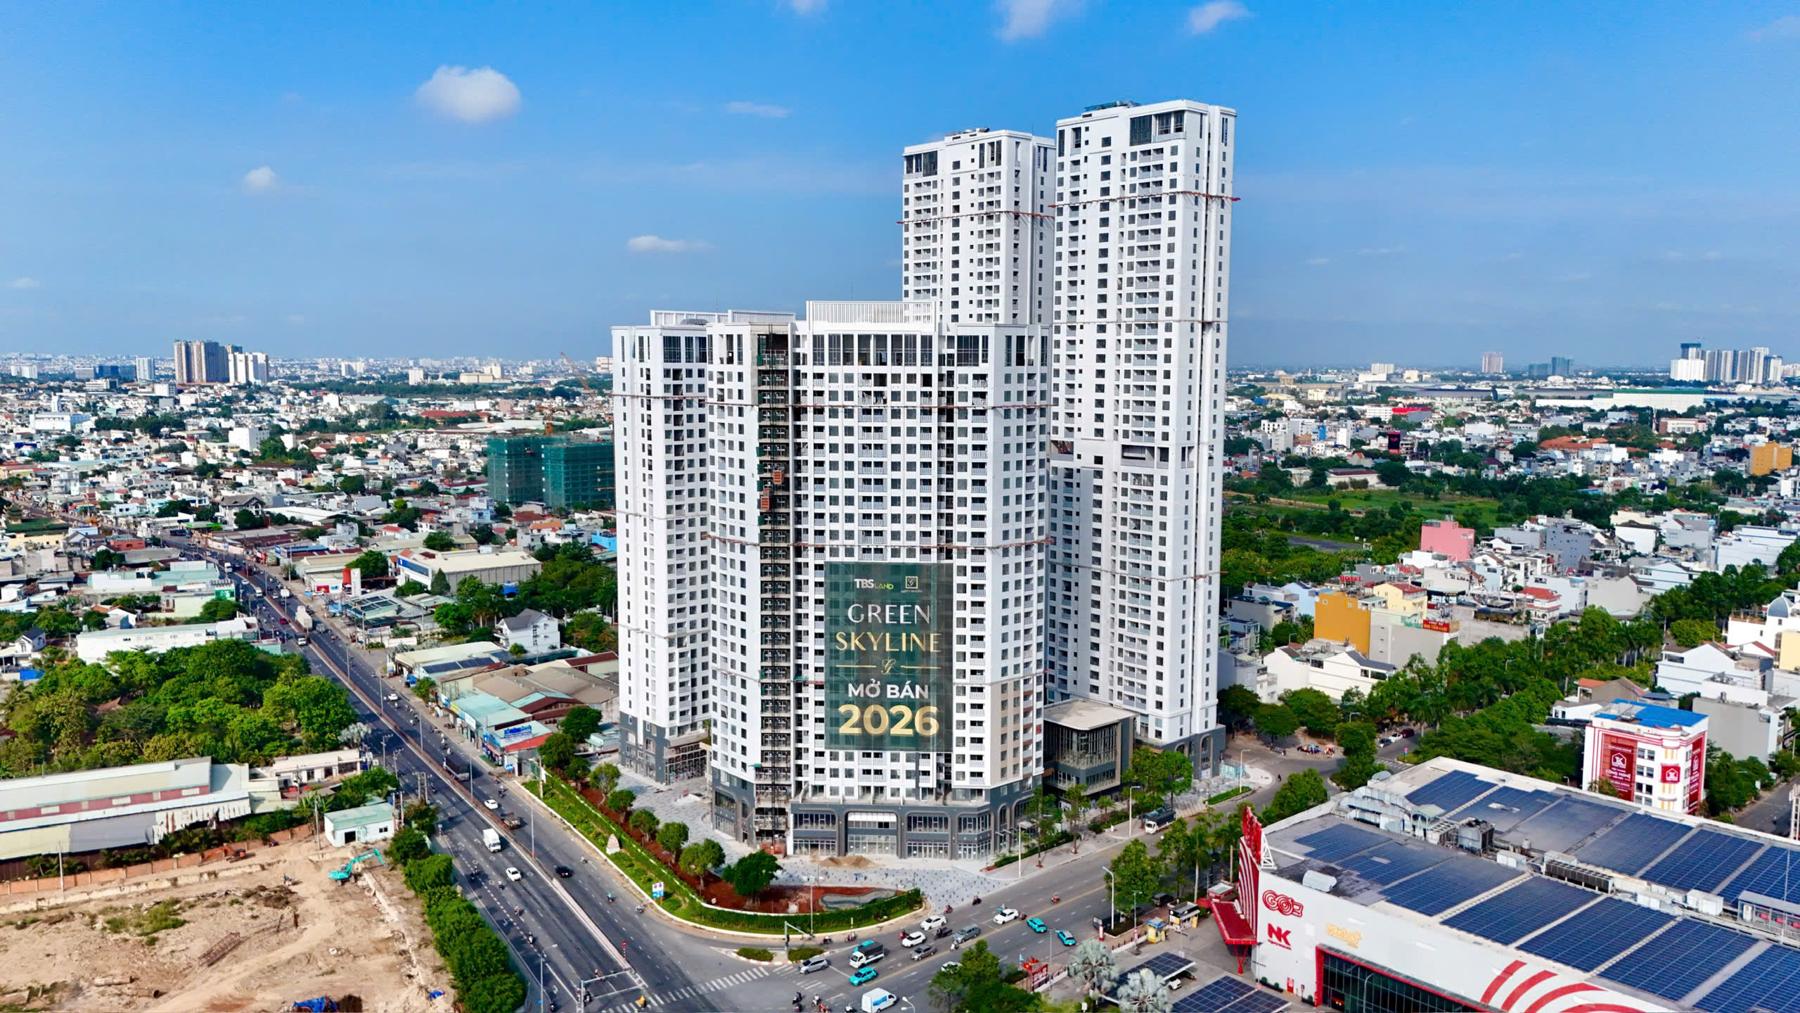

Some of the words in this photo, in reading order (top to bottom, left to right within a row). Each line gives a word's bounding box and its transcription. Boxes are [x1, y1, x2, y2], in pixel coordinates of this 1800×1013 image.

[854, 579, 874, 589] TBS
[847, 603, 930, 624] GREEN
[836, 631, 942, 652] SKYLINE
[848, 679, 881, 698] MỞ
[886, 681, 929, 699] BÁN
[838, 704, 940, 737] 2026
